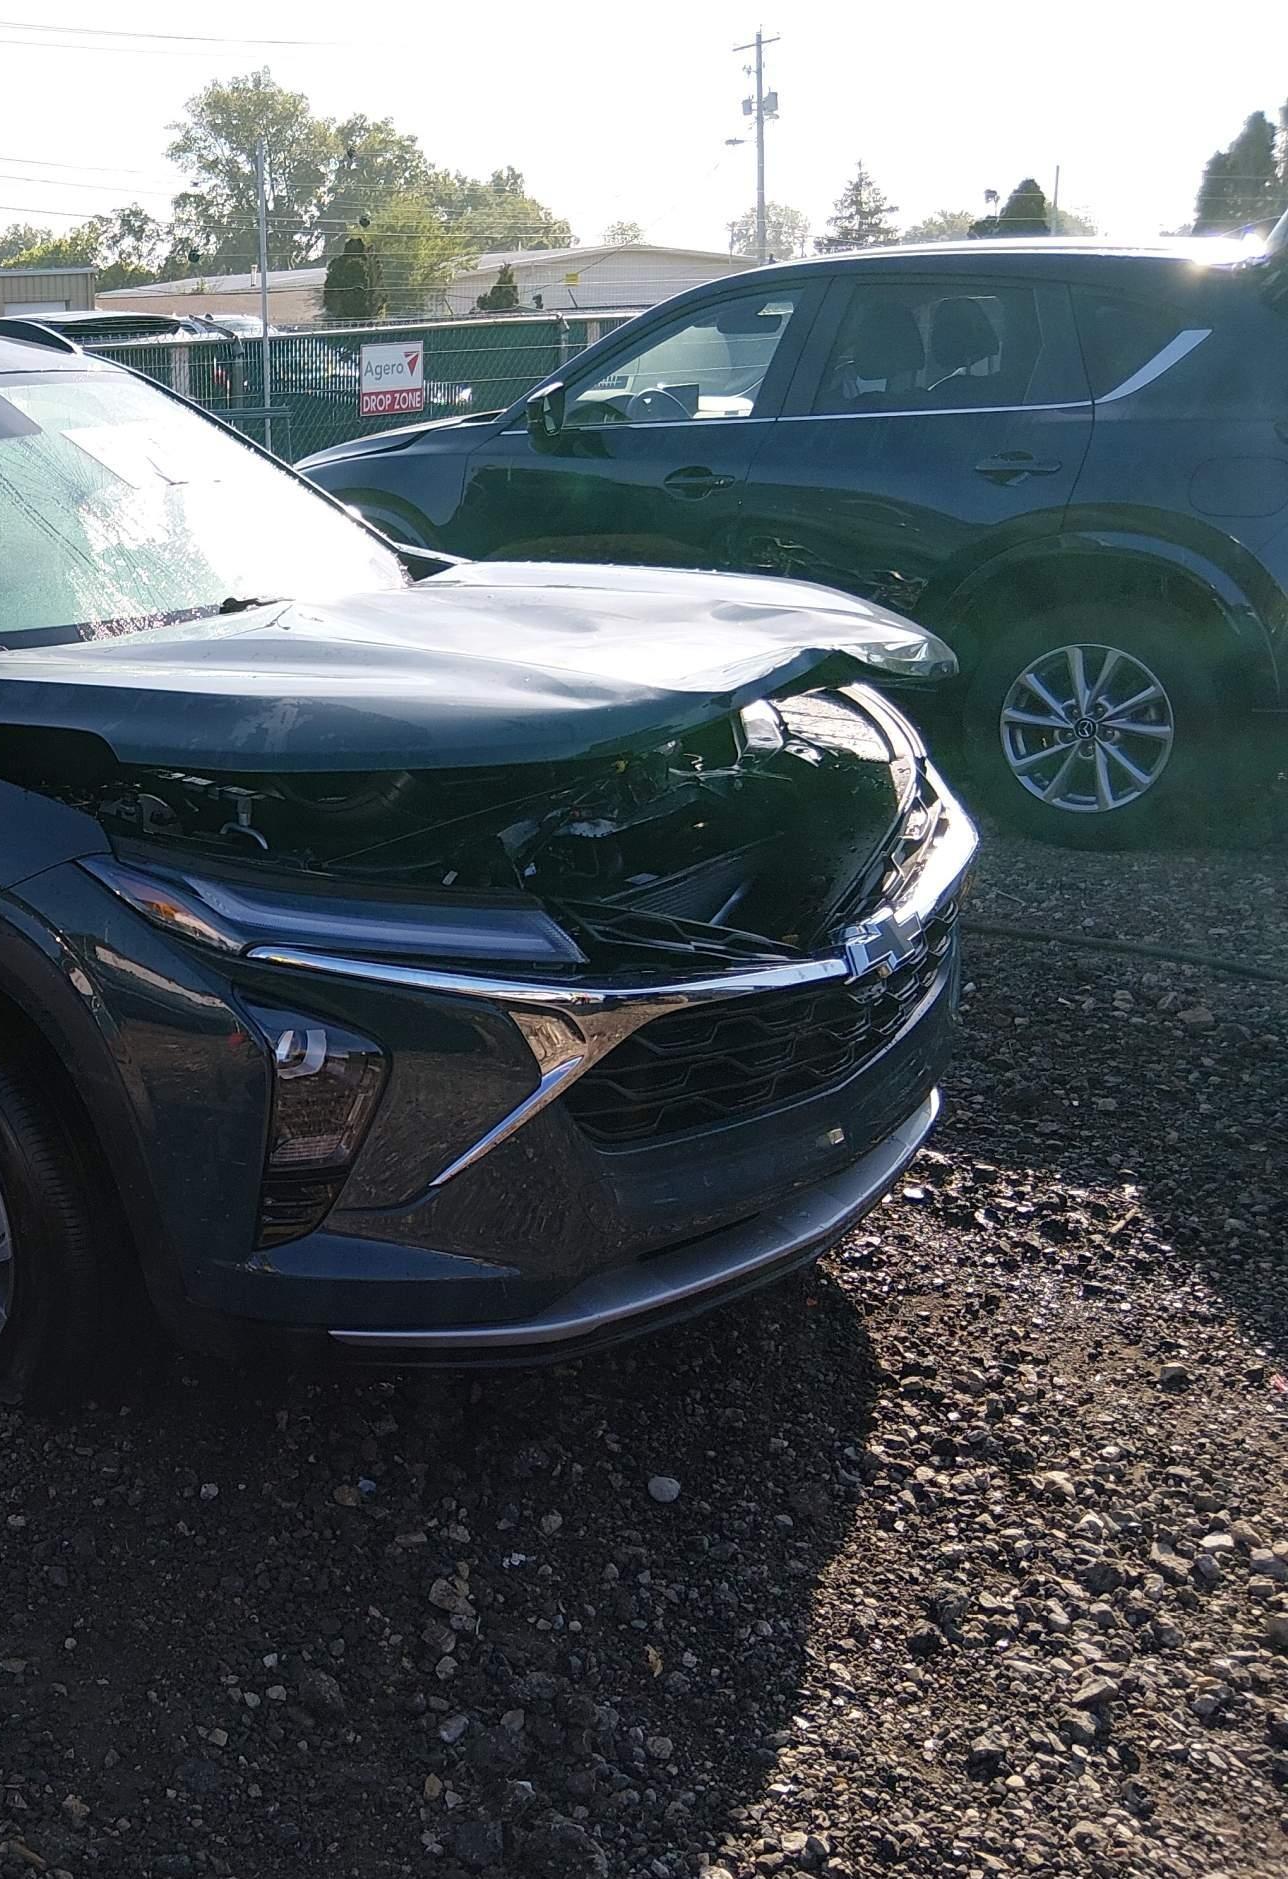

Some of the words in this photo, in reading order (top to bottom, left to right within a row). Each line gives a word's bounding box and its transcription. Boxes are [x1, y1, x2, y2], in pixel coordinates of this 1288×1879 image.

[364, 361, 404, 380] Agero
[363, 394, 391, 412] DROP
[394, 391, 421, 409] ZONE
